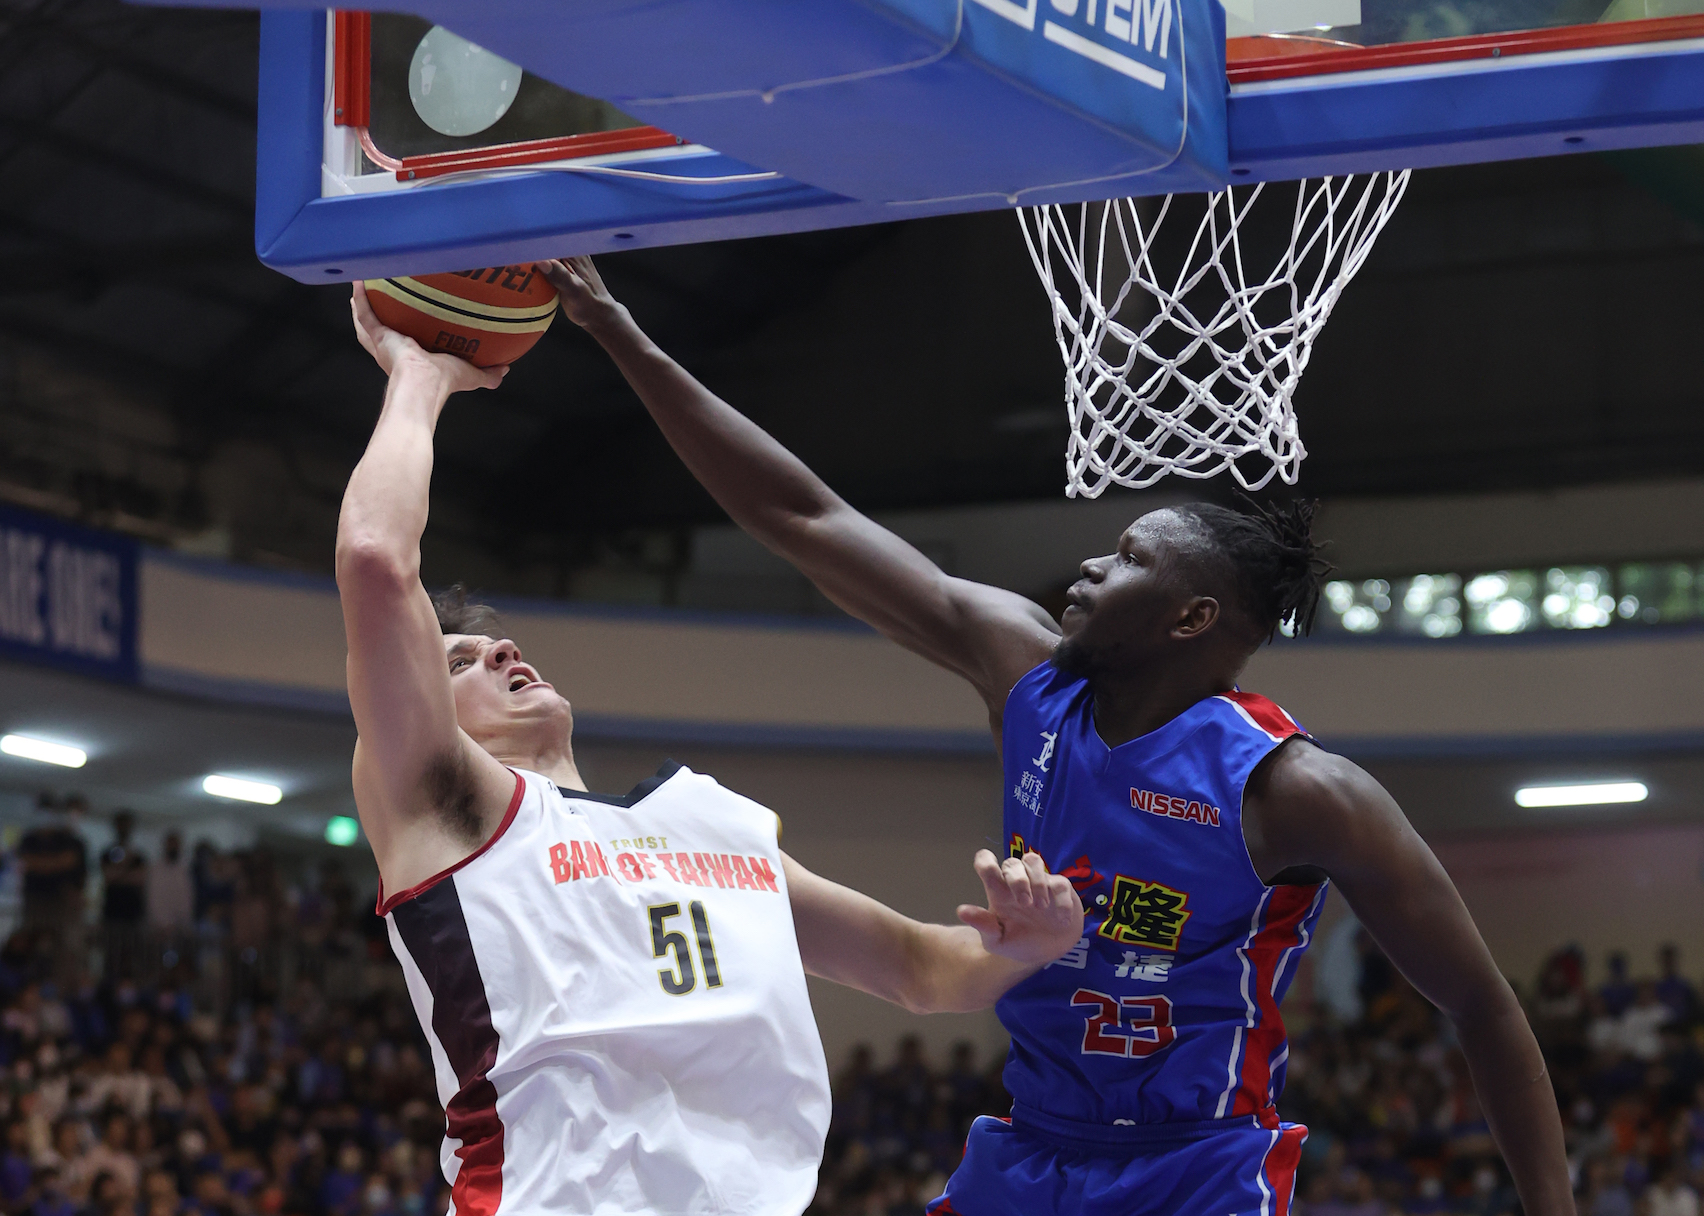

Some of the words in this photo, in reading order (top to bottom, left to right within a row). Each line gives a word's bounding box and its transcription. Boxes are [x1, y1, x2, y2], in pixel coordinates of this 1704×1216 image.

[434, 330, 481, 354] FIBA
[1130, 787, 1220, 827] NISSAN
[549, 839, 623, 886] BAN
[616, 851, 656, 883] OF
[655, 852, 780, 893] TAIWAN
[610, 836, 668, 850] TRUST
[647, 900, 724, 997] 51
[1070, 988, 1178, 1059] 23
